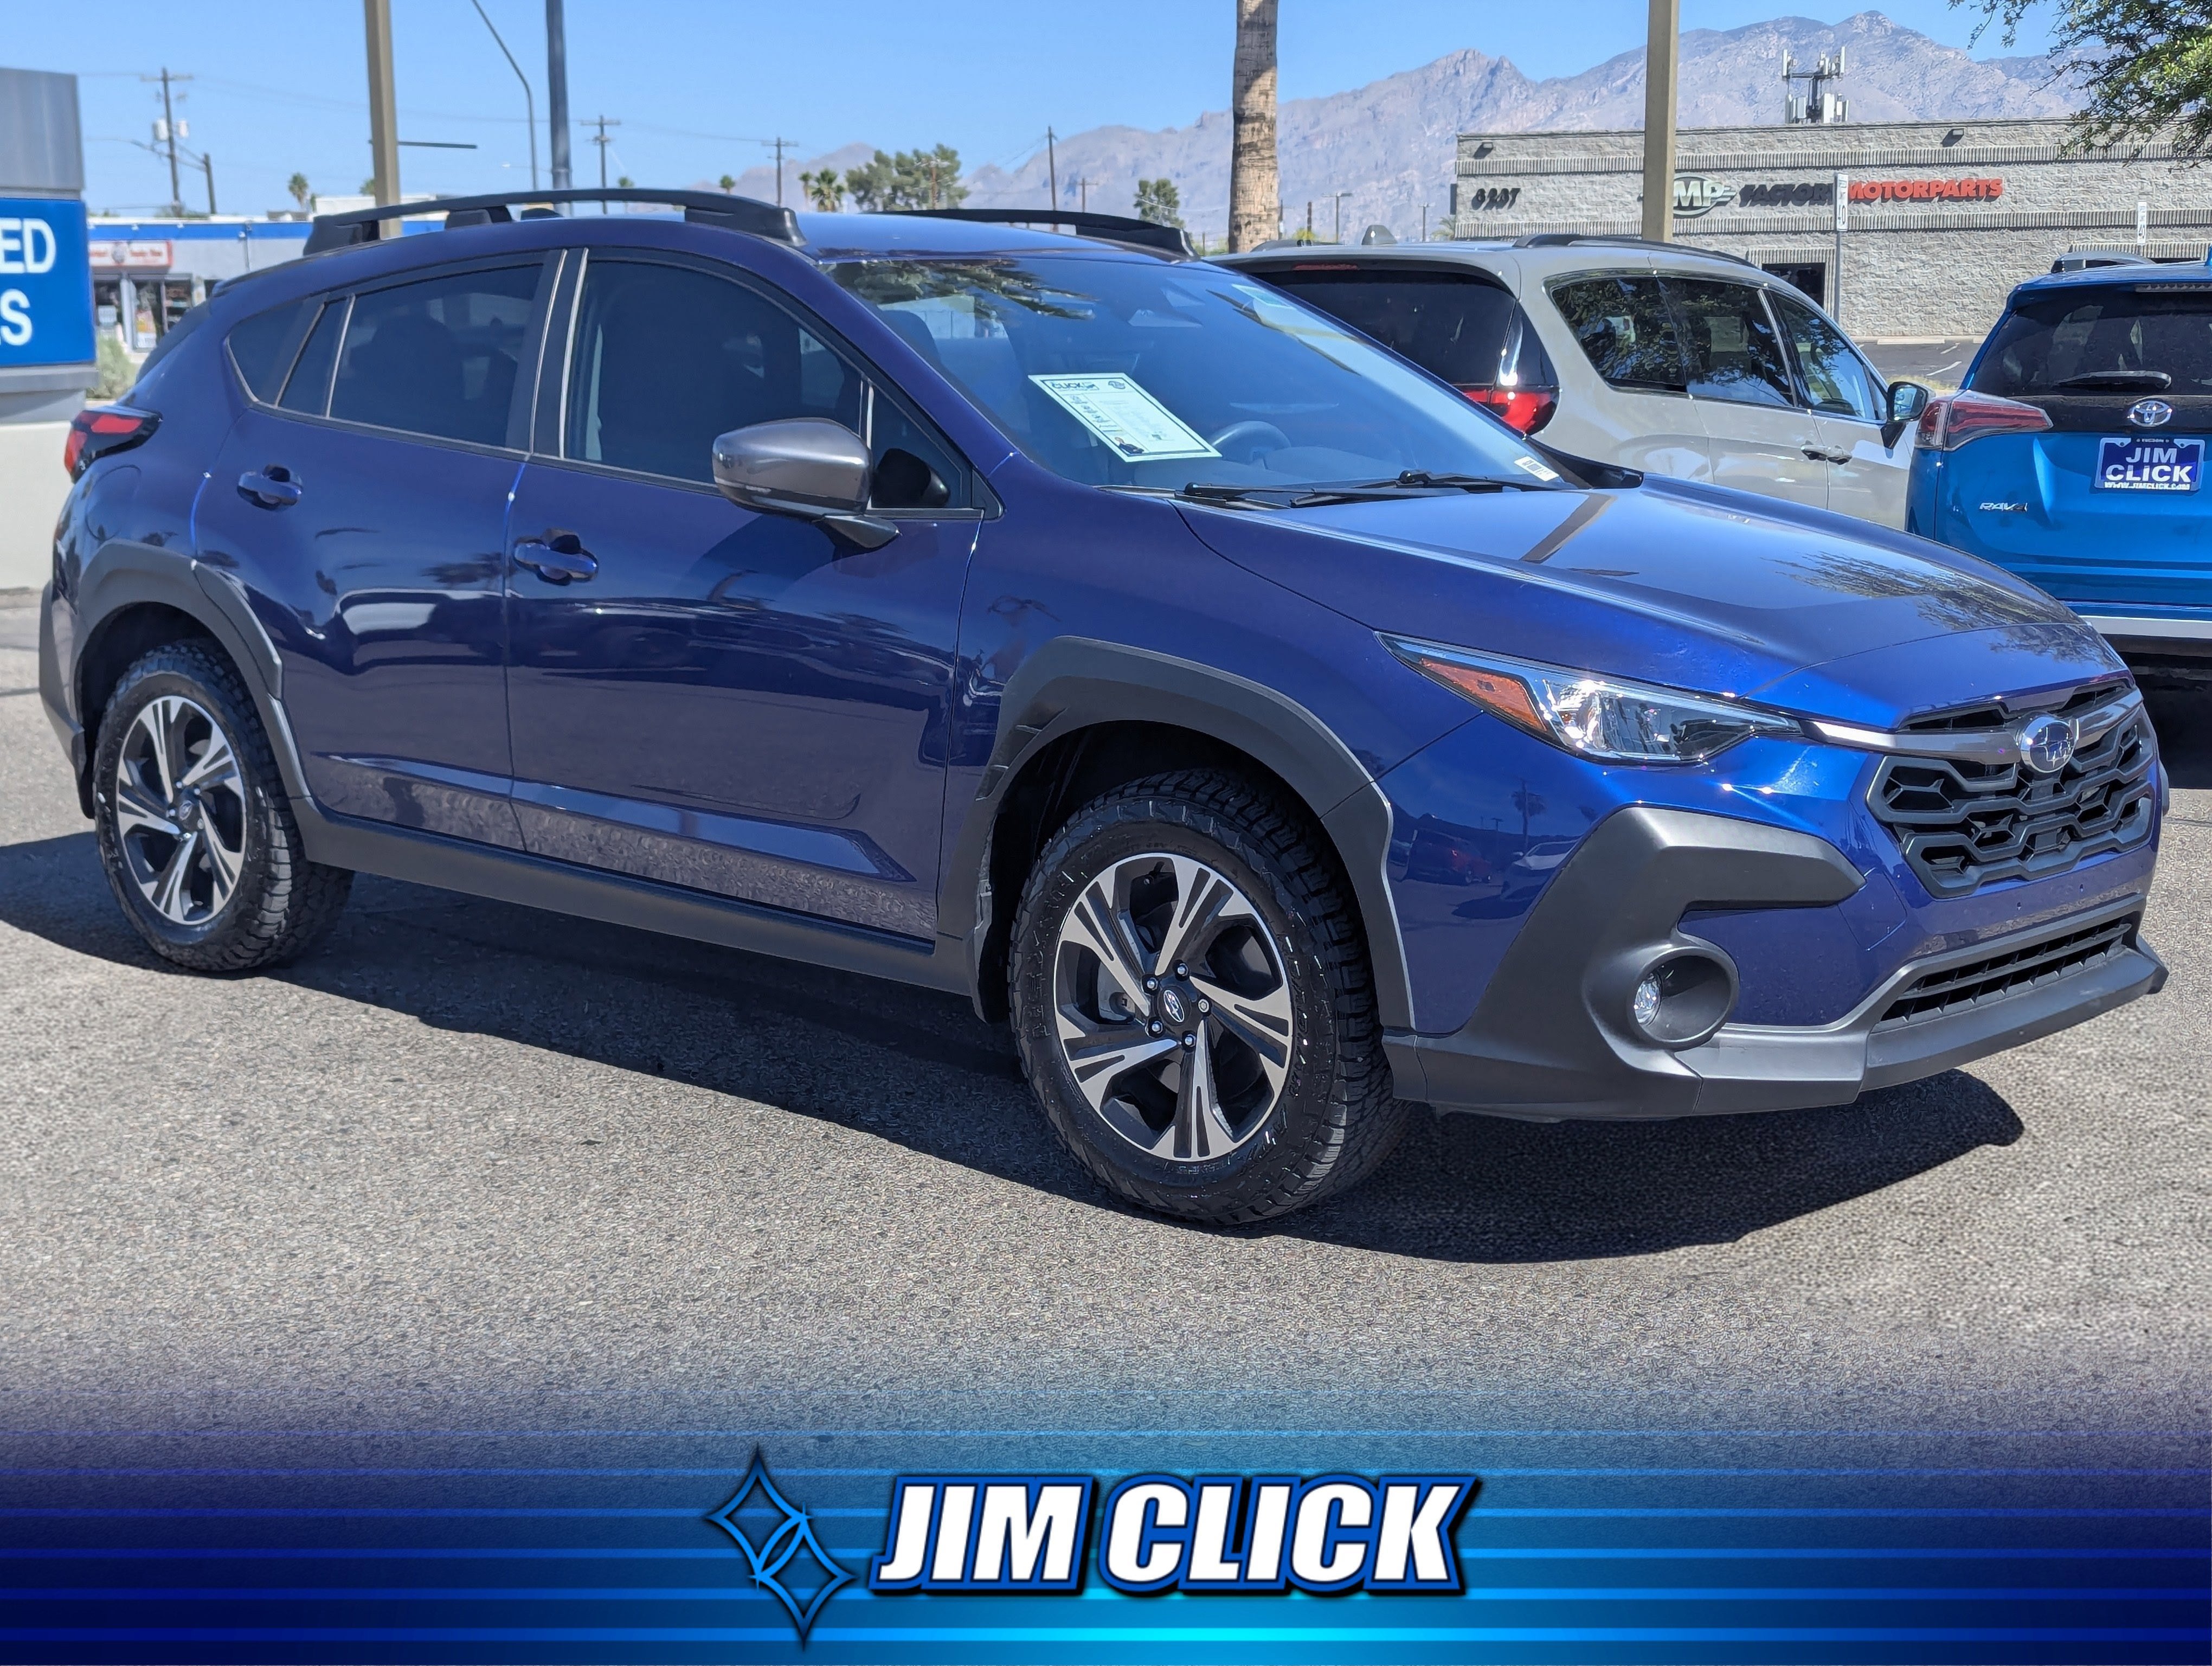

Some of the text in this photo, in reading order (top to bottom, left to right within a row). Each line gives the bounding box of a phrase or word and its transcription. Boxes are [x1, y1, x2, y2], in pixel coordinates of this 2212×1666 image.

[1674, 181, 1724, 207] MP
[1739, 183, 1834, 206] FACTOR
[0, 218, 56, 273] ED
[0, 289, 33, 346] S
[2125, 447, 2177, 464] JIM
[2106, 464, 2192, 482] CLICK
[1979, 502, 2028, 512] RAV4
